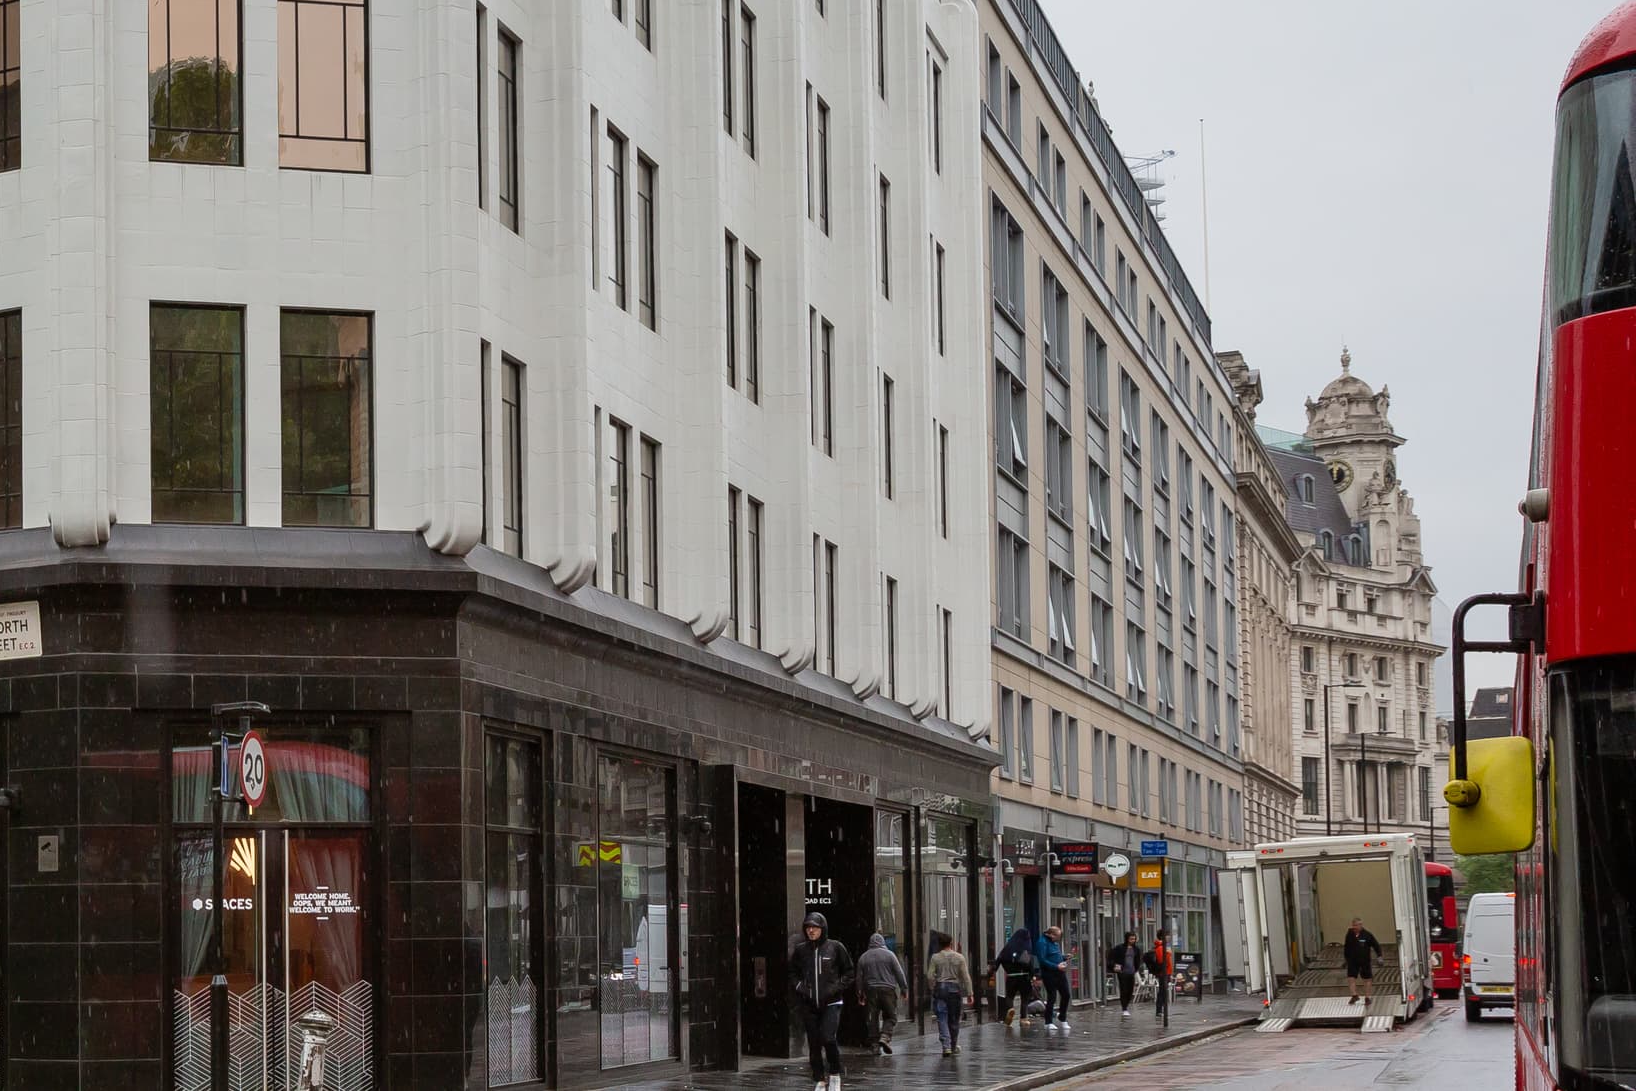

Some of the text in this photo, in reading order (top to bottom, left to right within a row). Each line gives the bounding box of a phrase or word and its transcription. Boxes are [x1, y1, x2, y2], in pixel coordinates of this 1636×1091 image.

[244, 752, 264, 785] 20
[805, 878, 832, 895] TH
[205, 898, 253, 910] SACES
[315, 899, 326, 907] WE
